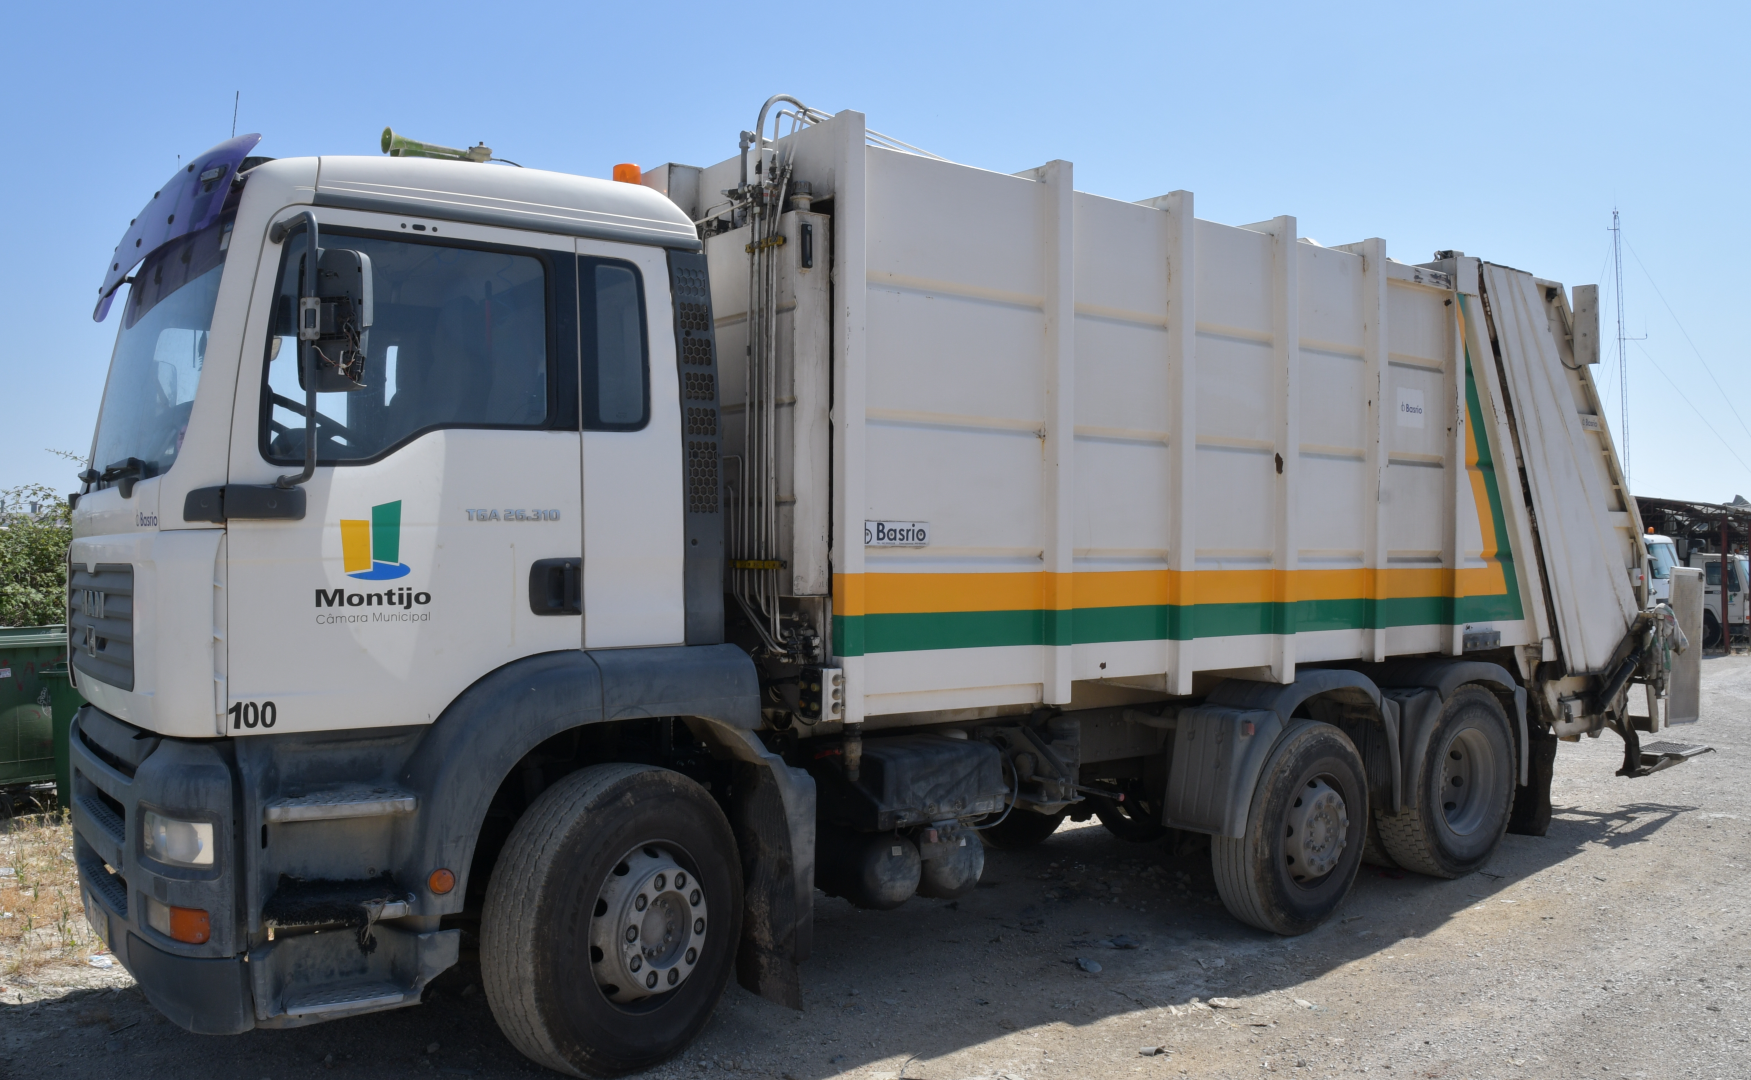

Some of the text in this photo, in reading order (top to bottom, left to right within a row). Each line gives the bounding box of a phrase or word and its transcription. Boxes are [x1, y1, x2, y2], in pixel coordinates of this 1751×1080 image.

[139, 511, 158, 527] Basrio
[466, 508, 561, 522] TGA 26.310
[877, 522, 927, 542] Basrio
[81, 589, 105, 619] MAN
[315, 587, 432, 610] Montijo
[315, 611, 431, 625] Câmara Municipal
[228, 700, 277, 730] 100
